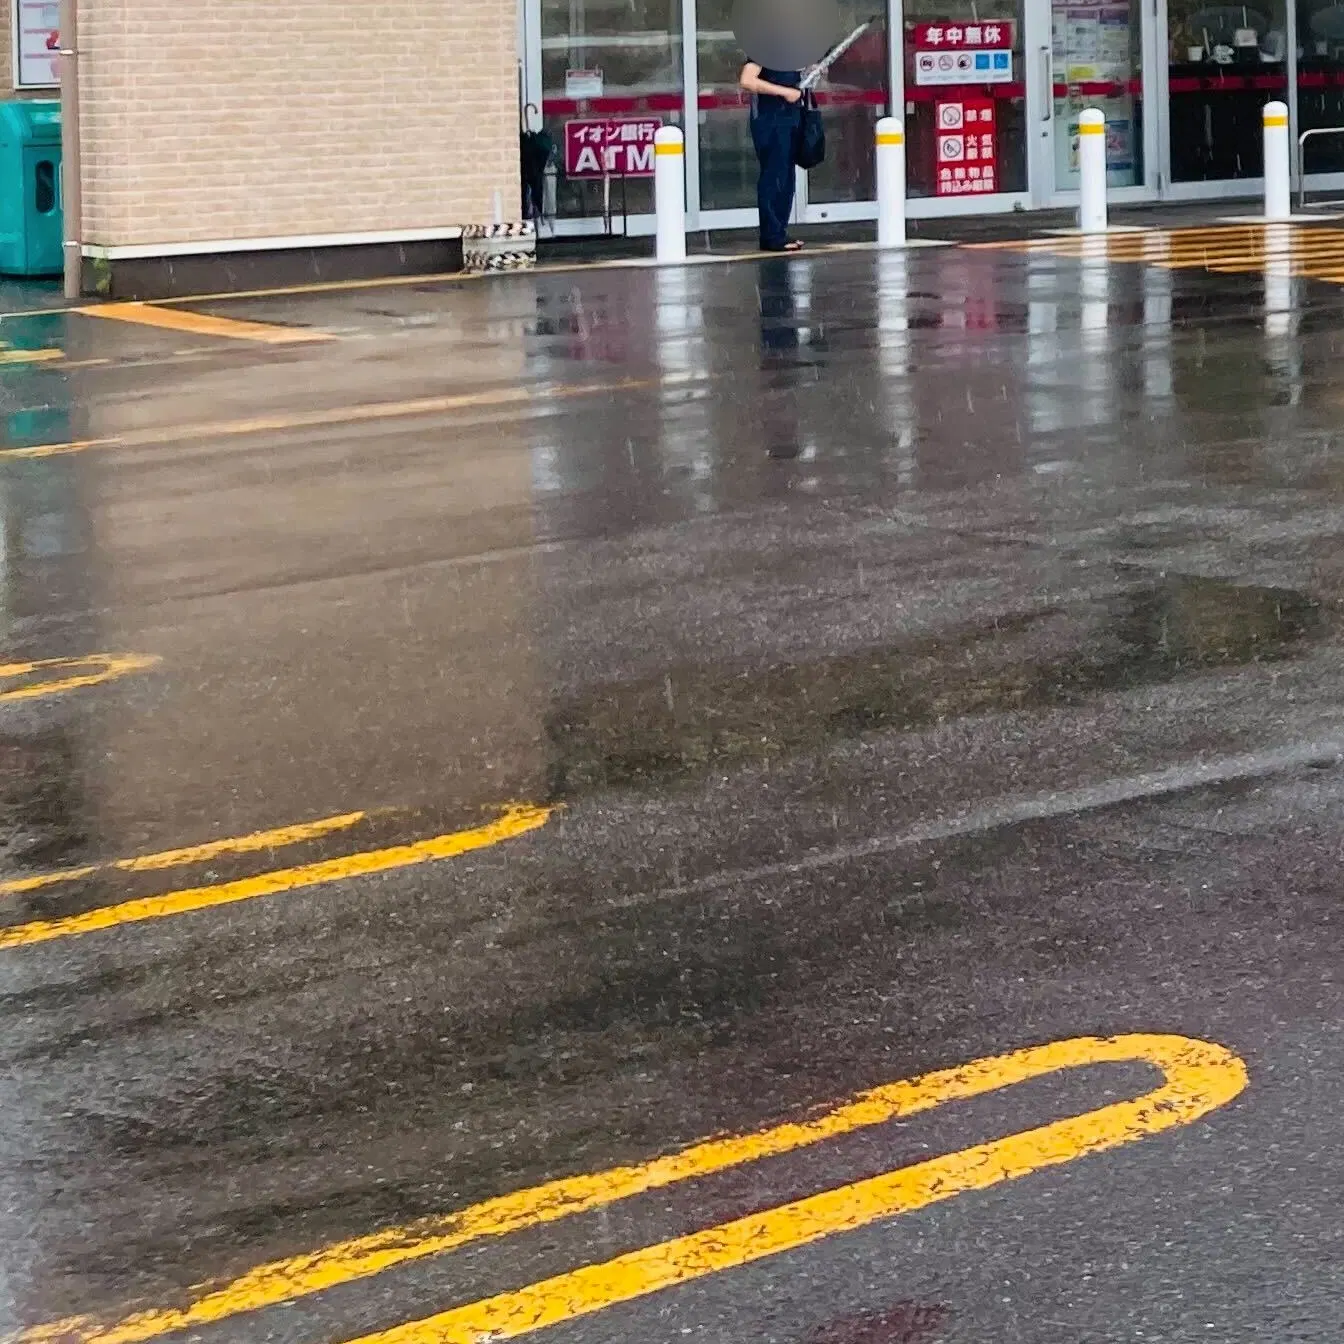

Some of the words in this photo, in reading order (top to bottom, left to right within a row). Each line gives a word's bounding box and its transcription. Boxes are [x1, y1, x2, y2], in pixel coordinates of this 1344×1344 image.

[925, 25, 1001, 45] 年中無休
[573, 123, 655, 143] イオン銀行
[575, 144, 655, 172] ATM
